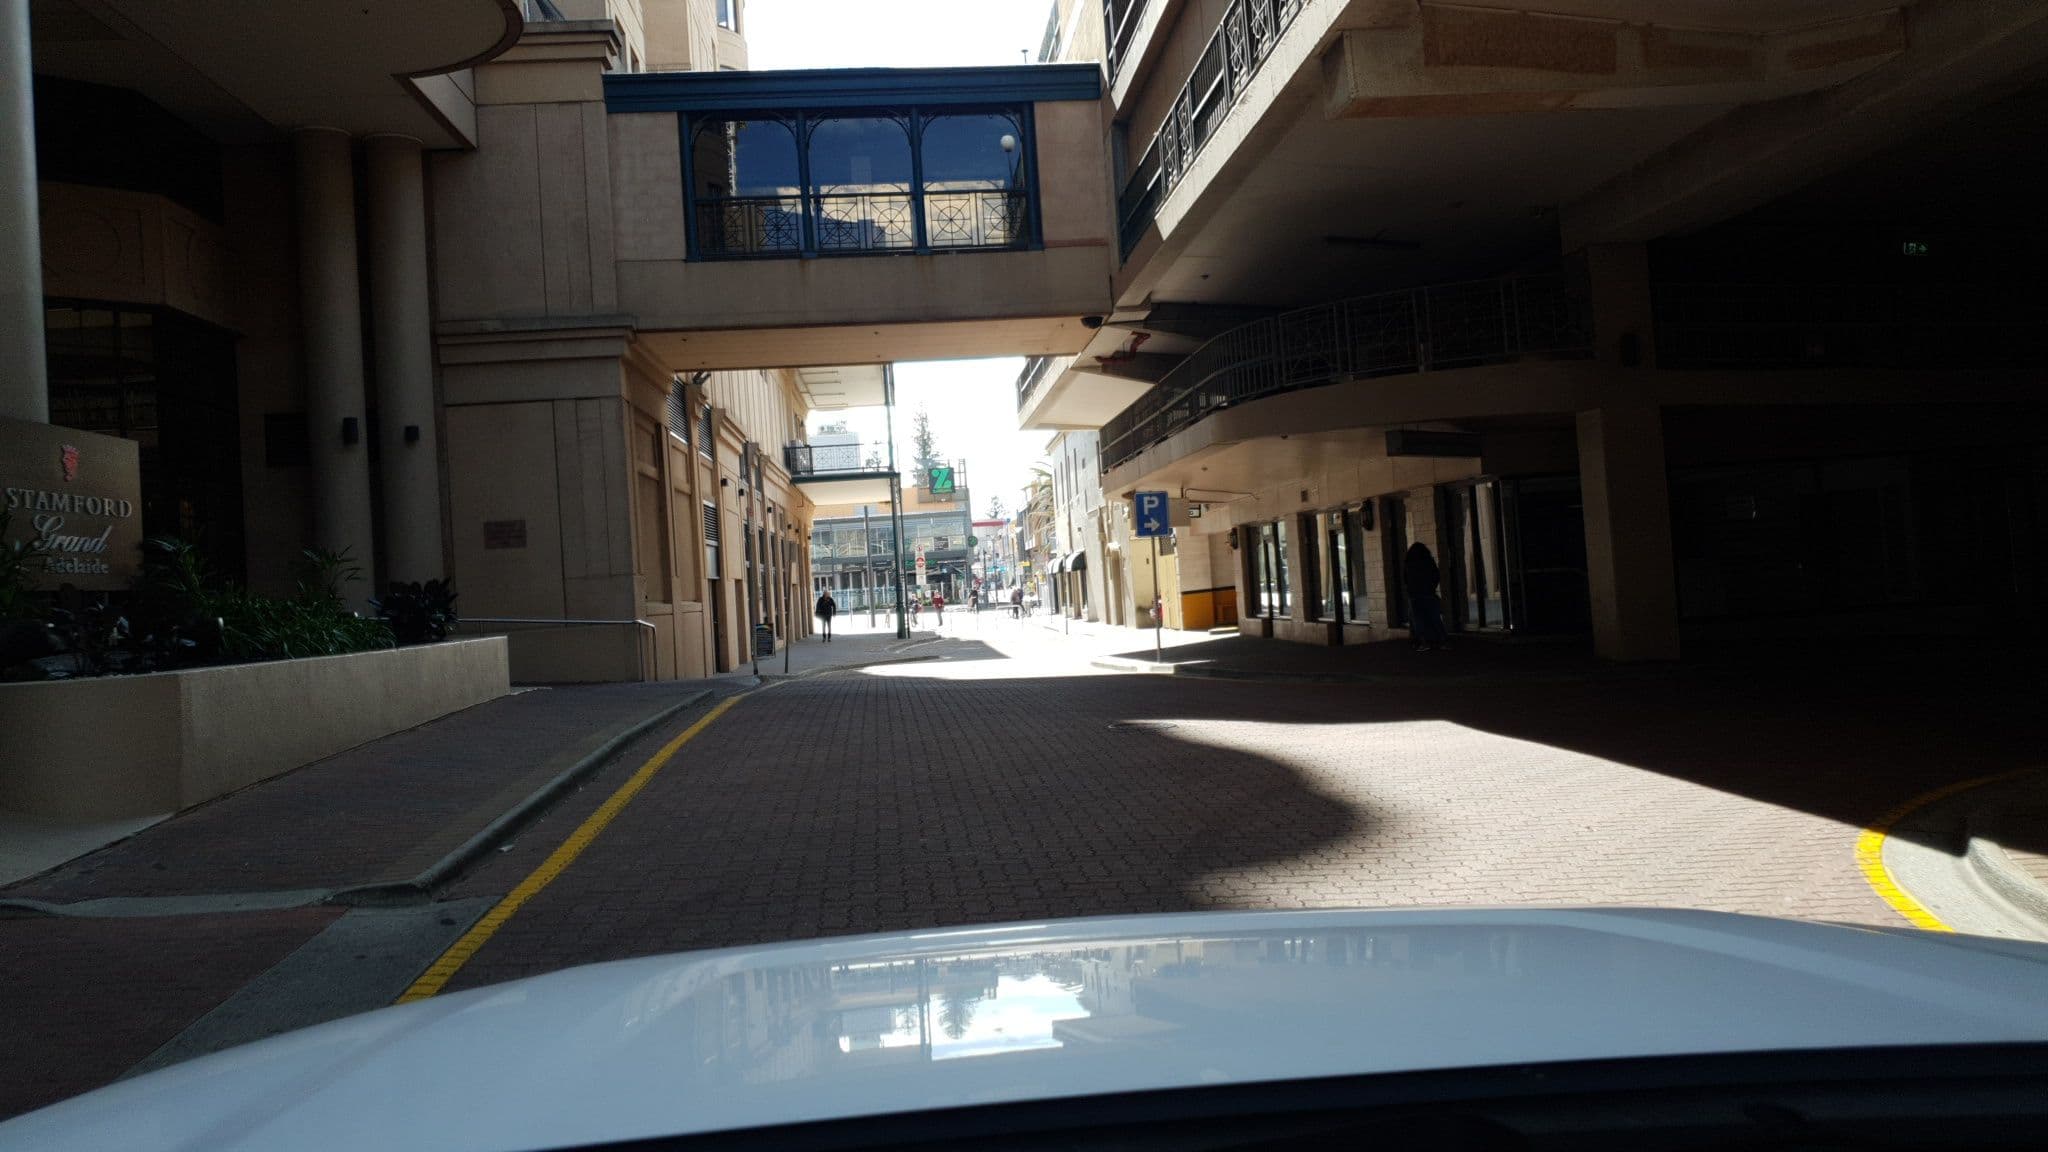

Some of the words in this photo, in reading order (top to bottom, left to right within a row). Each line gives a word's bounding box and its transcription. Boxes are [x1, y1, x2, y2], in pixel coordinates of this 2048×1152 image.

[6, 487, 132, 518] STAMFORD
[1143, 496, 1159, 515] P
[32, 514, 112, 553] Grand
